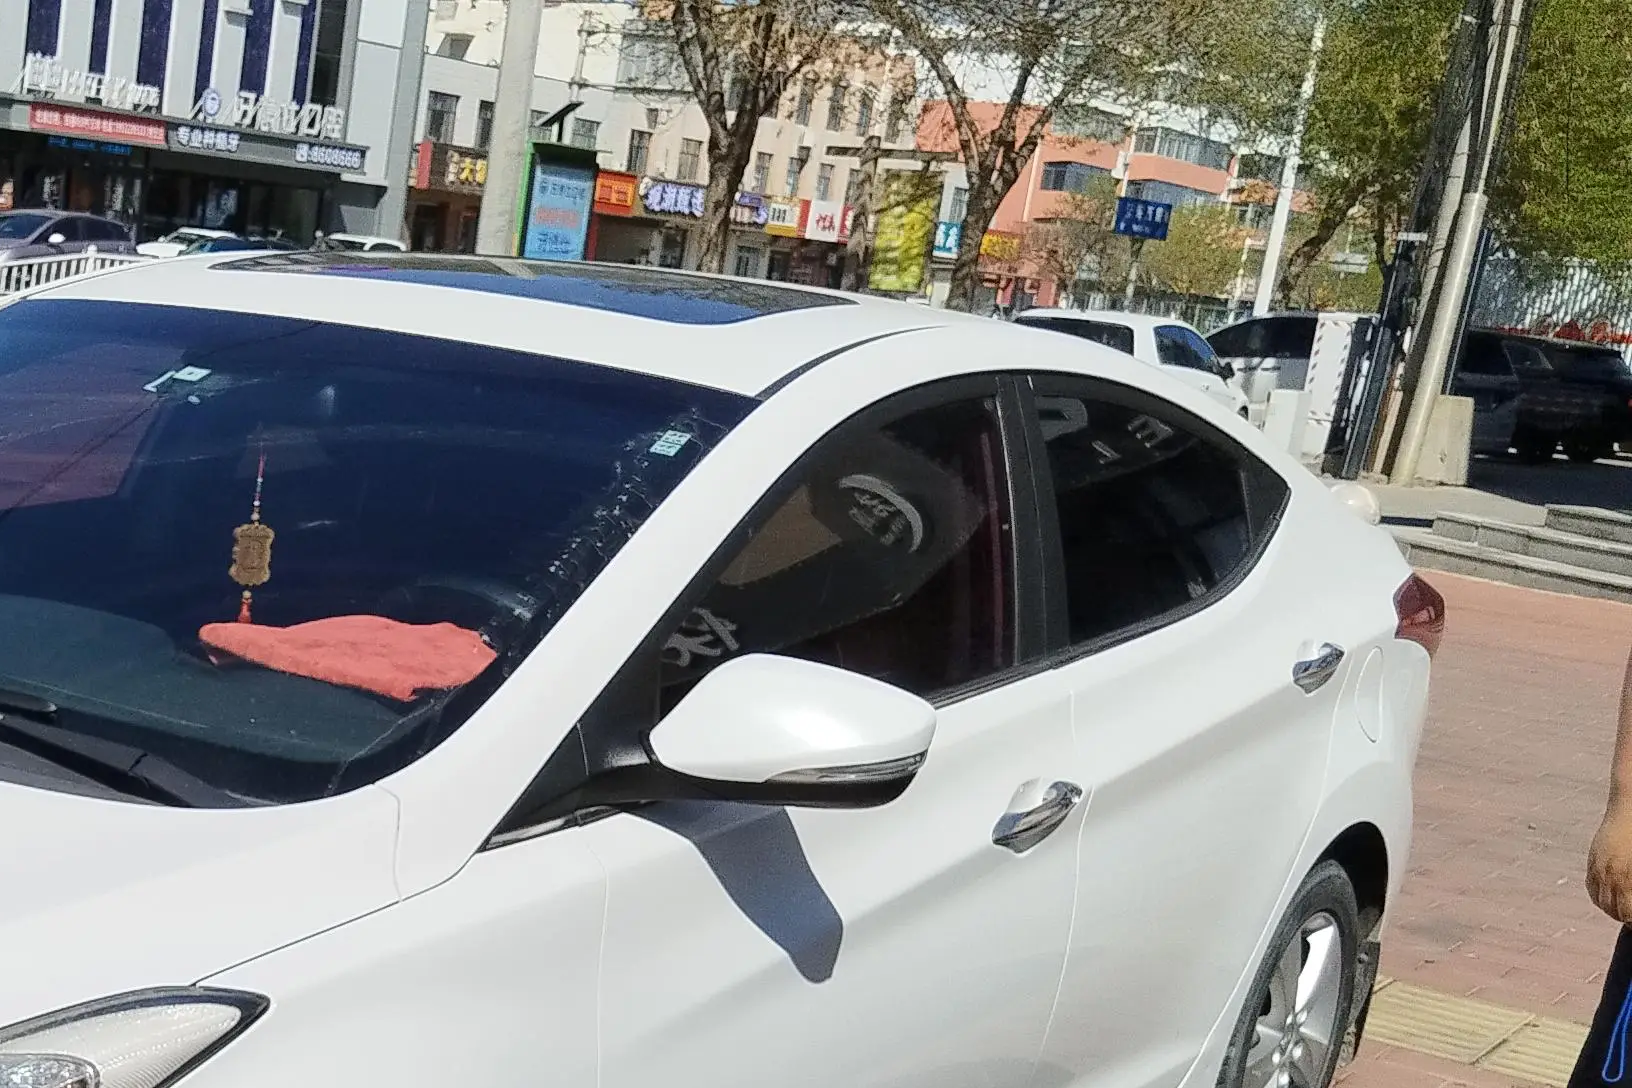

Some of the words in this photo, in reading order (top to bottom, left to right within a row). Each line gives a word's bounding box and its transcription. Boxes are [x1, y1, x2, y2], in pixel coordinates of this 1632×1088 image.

[176, 126, 241, 152] 专业种植牙
